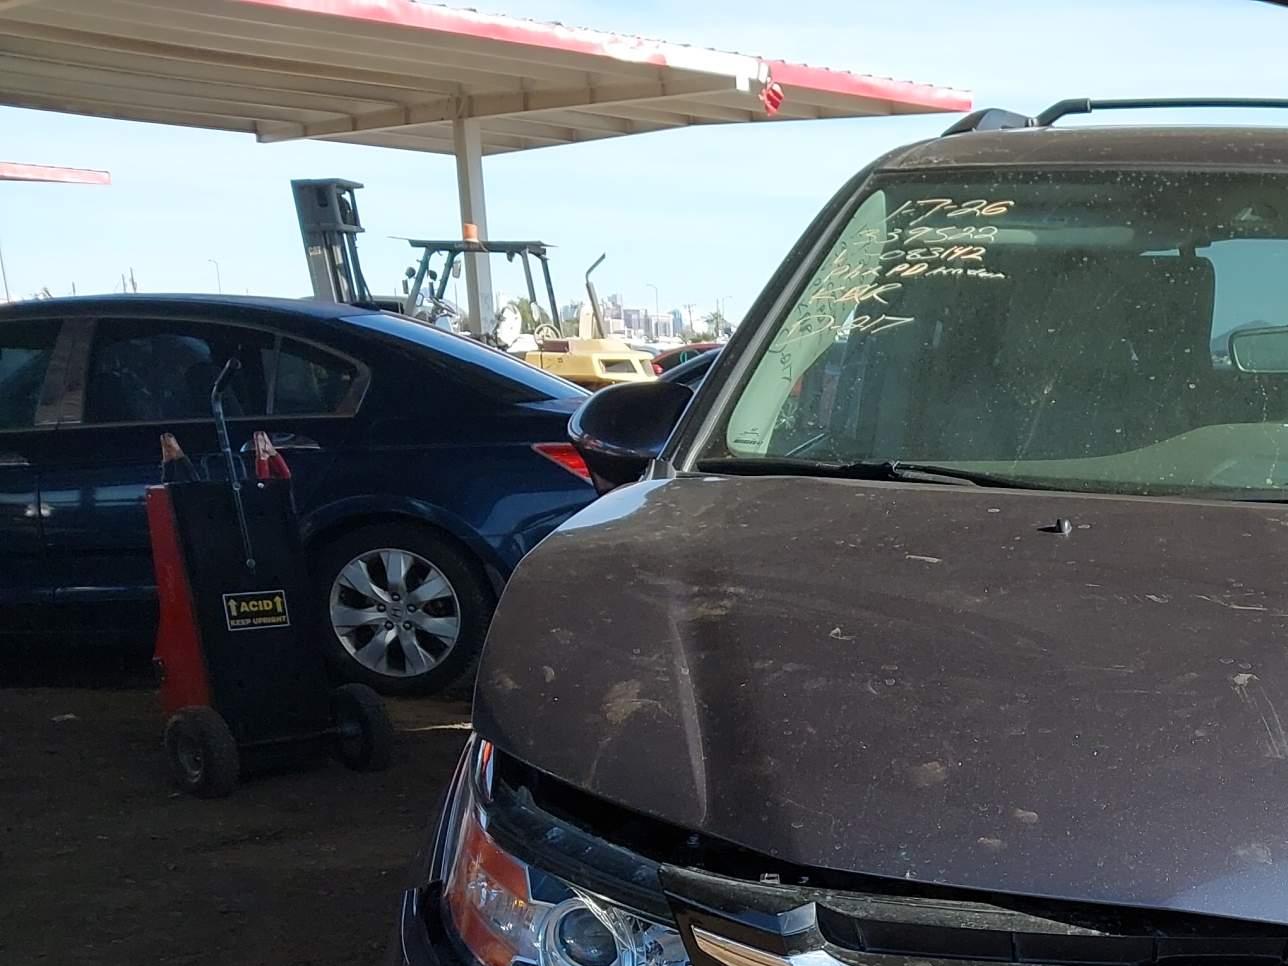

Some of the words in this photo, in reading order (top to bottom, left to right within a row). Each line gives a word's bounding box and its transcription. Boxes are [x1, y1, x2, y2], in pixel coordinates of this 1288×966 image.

[240, 600, 272, 612] ACID
[231, 618, 251, 626] KEEP
[253, 615, 286, 625] UPRIGHT
